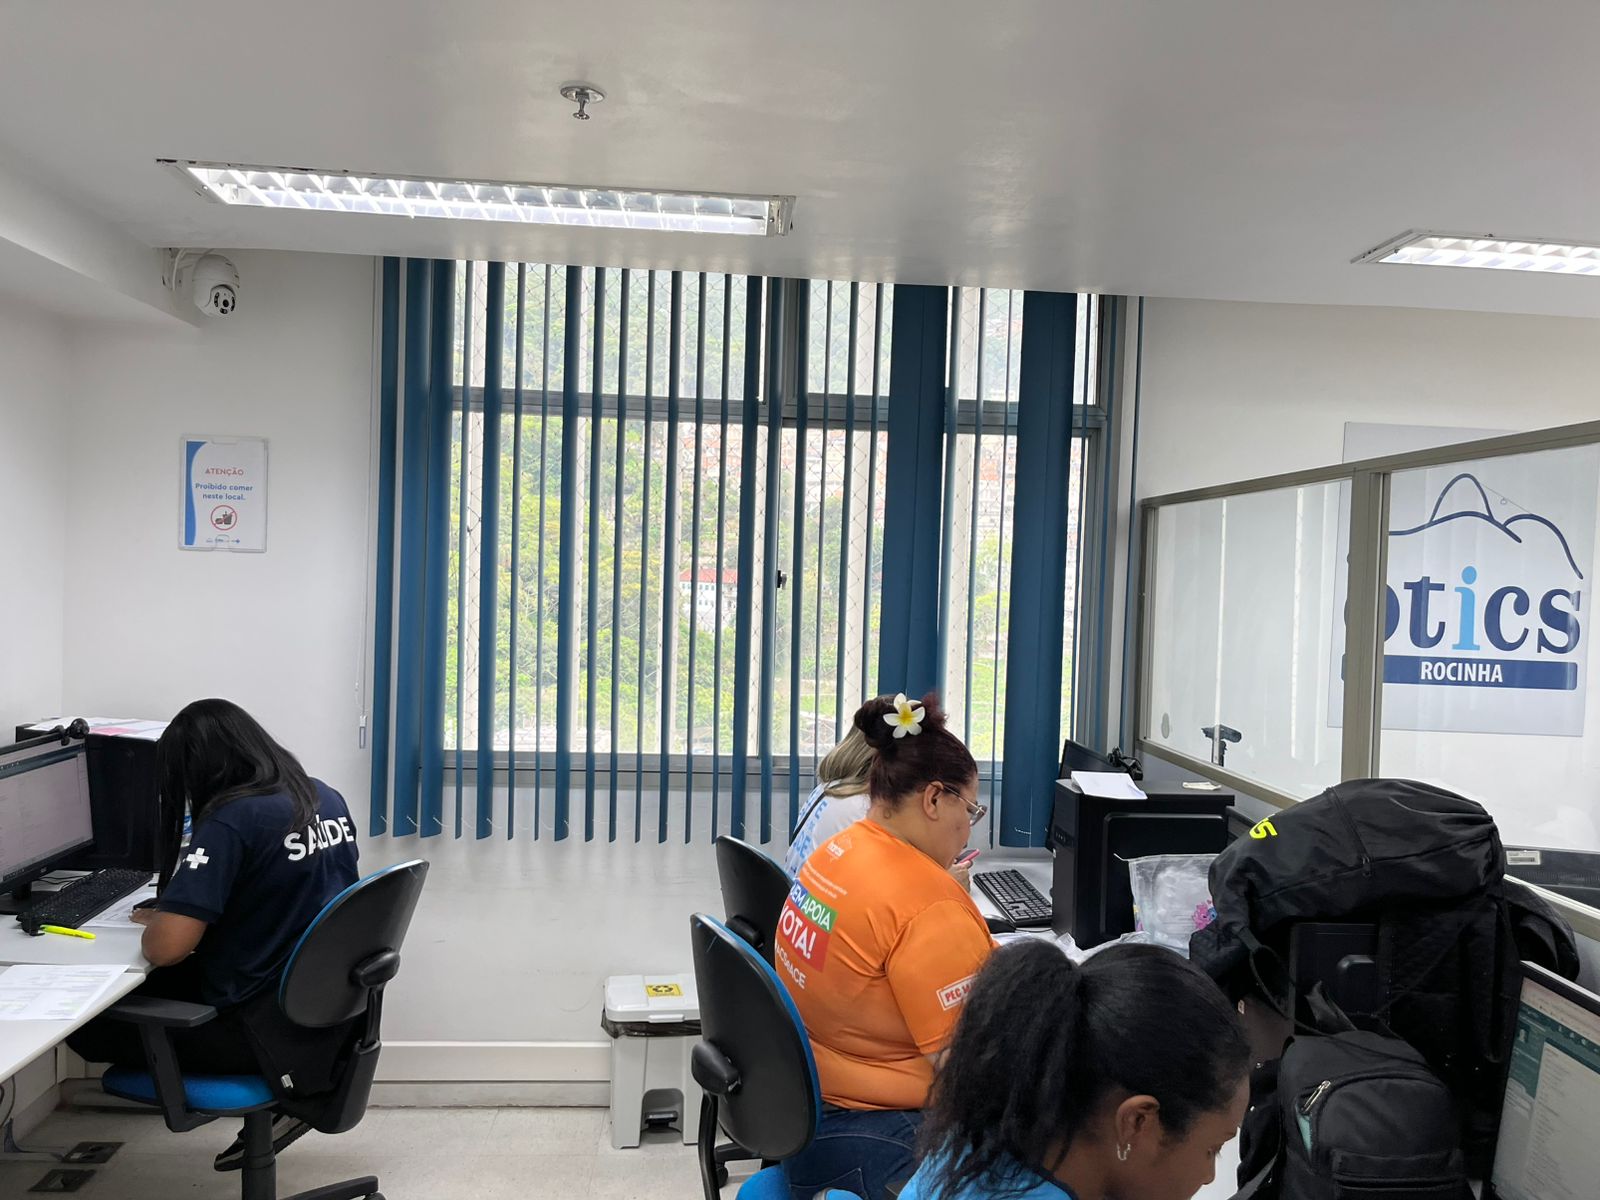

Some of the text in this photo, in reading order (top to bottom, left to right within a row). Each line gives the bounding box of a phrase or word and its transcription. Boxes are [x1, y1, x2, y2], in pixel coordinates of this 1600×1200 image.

[205, 466, 244, 476] ATENÇÃO
[195, 482, 227, 490] Proibido
[1420, 661, 1503, 683] ROCINHA
[284, 814, 354, 861] SAÚDE
[801, 897, 831, 931] APOIA
